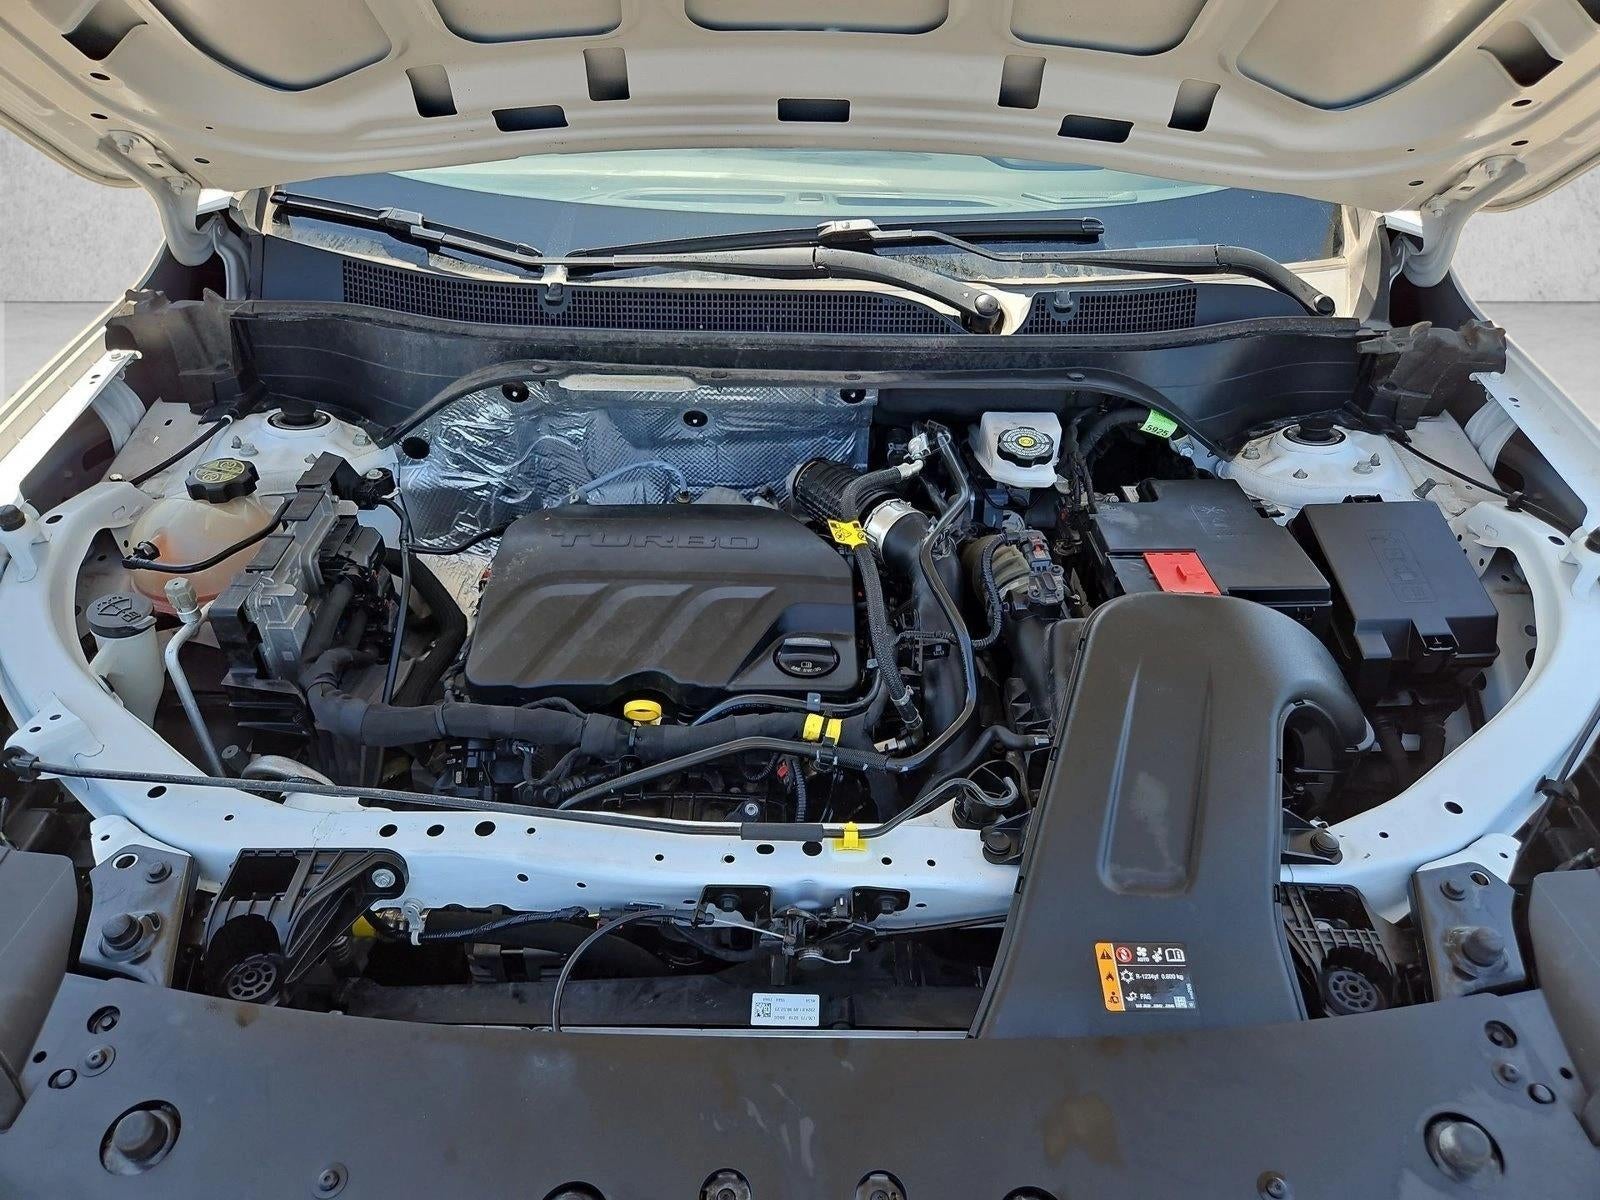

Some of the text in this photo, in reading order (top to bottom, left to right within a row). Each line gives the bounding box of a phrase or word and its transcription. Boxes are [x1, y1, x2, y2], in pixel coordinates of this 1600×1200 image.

[1145, 424, 1169, 437] 5925
[551, 532, 760, 551] TURBO
[1176, 973, 1184, 981] kg
